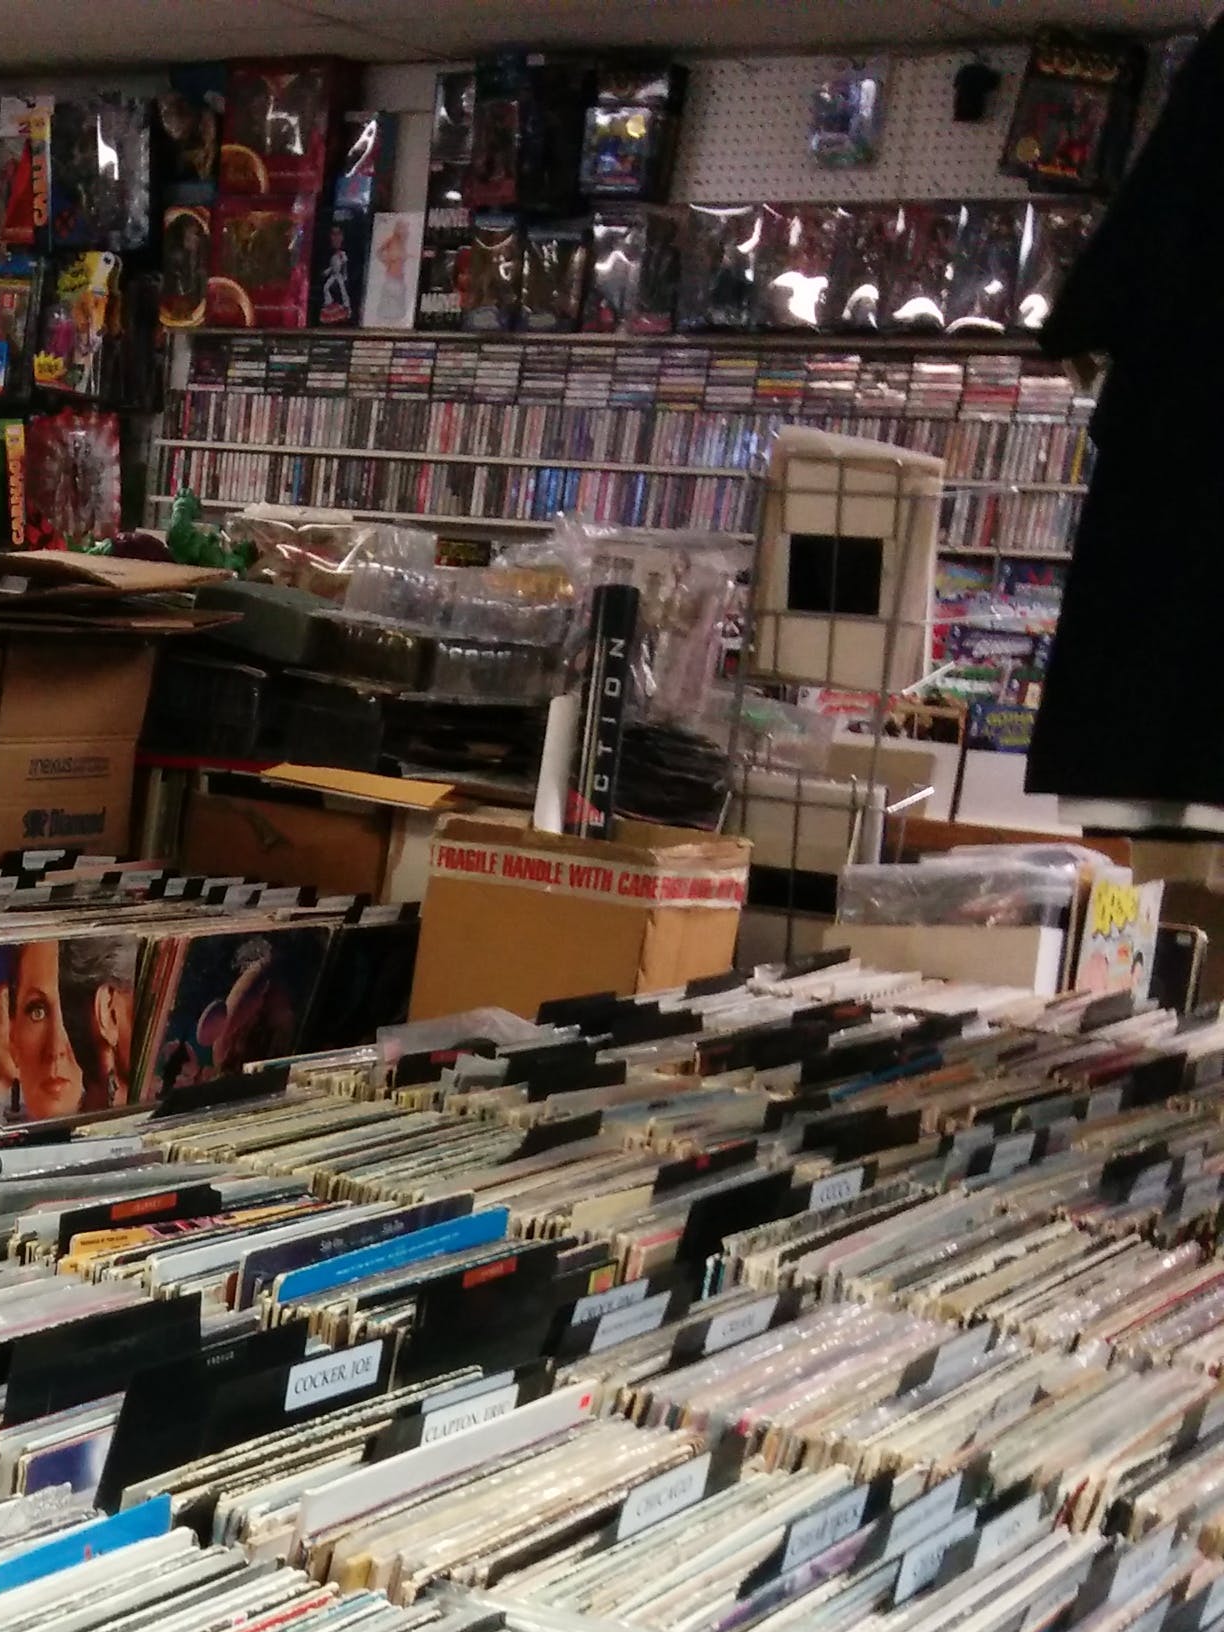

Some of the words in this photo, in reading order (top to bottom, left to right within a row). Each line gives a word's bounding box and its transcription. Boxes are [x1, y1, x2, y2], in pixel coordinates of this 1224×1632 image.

[437, 845, 498, 874] FRAGILE
[502, 853, 563, 887] HANDLE
[568, 863, 613, 893] WITH
